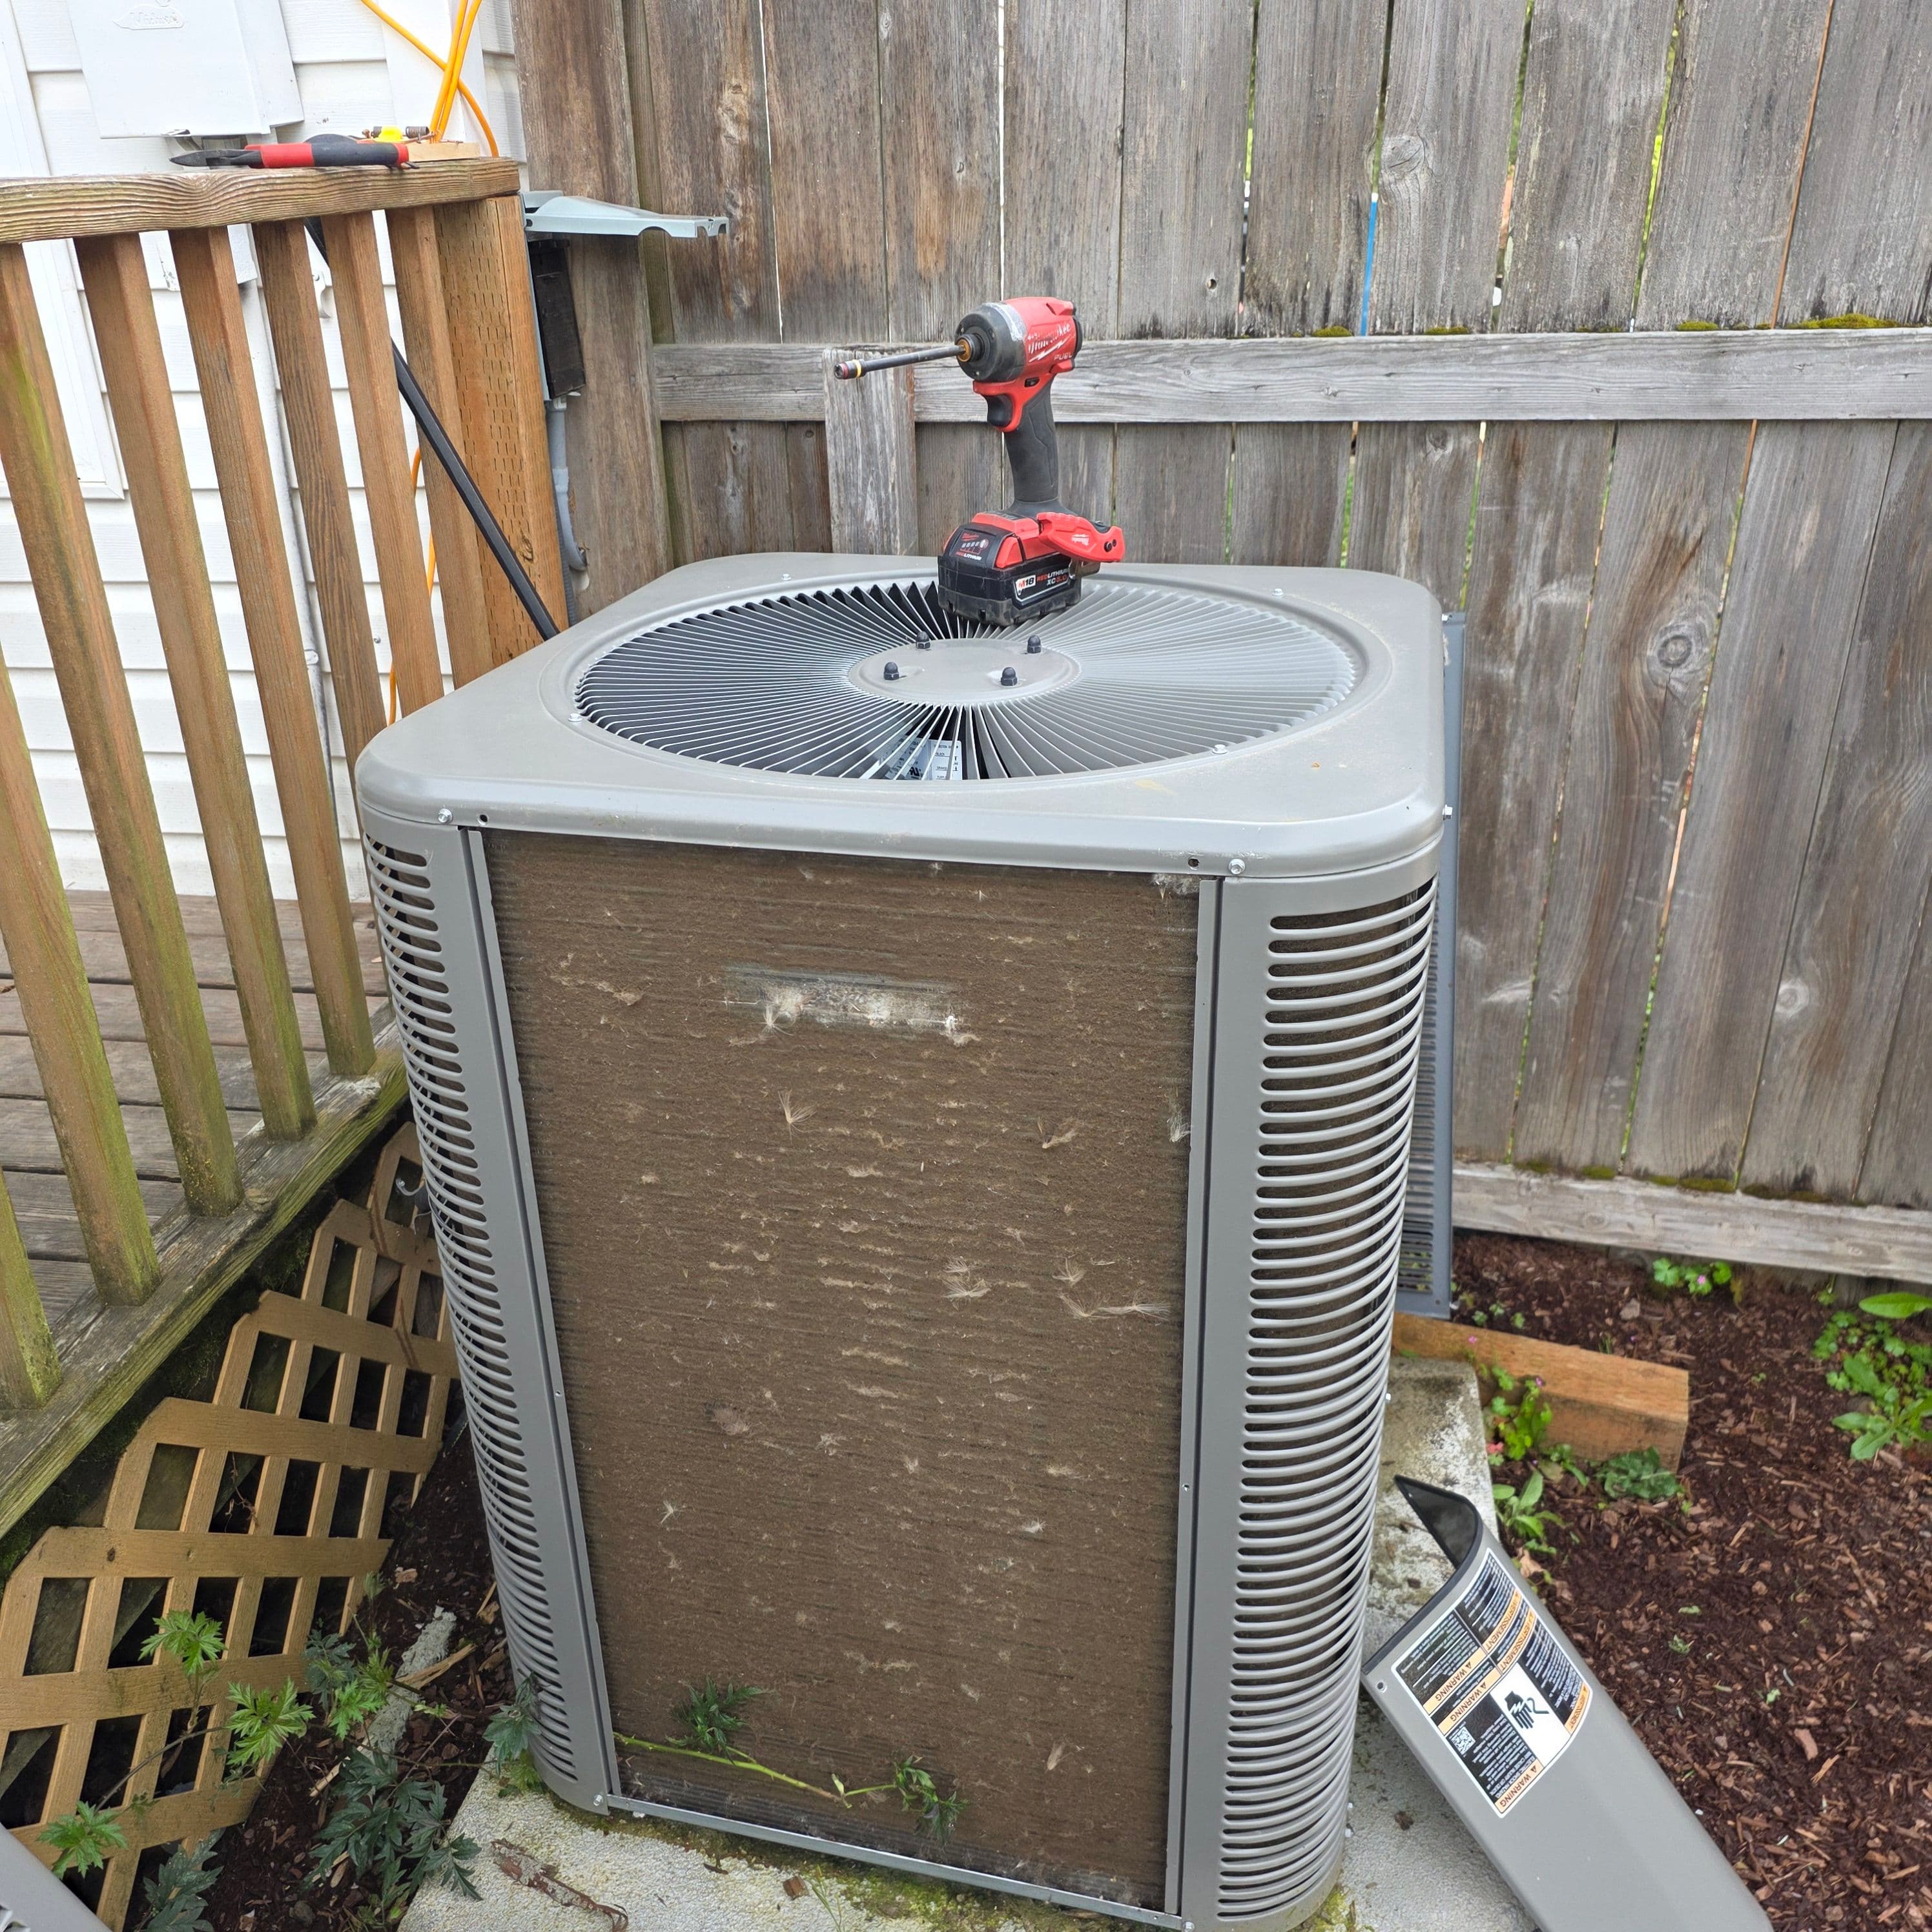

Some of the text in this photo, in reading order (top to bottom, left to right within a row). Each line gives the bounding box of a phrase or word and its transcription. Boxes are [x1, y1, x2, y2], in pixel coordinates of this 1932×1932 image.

[1054, 353, 1072, 361] FUEL
[1018, 577, 1034, 588] M18
[1434, 1667, 1466, 1701] WARNING
[1449, 1688, 1481, 1721] WARNING
[1498, 1773, 1532, 1807] WARNING
